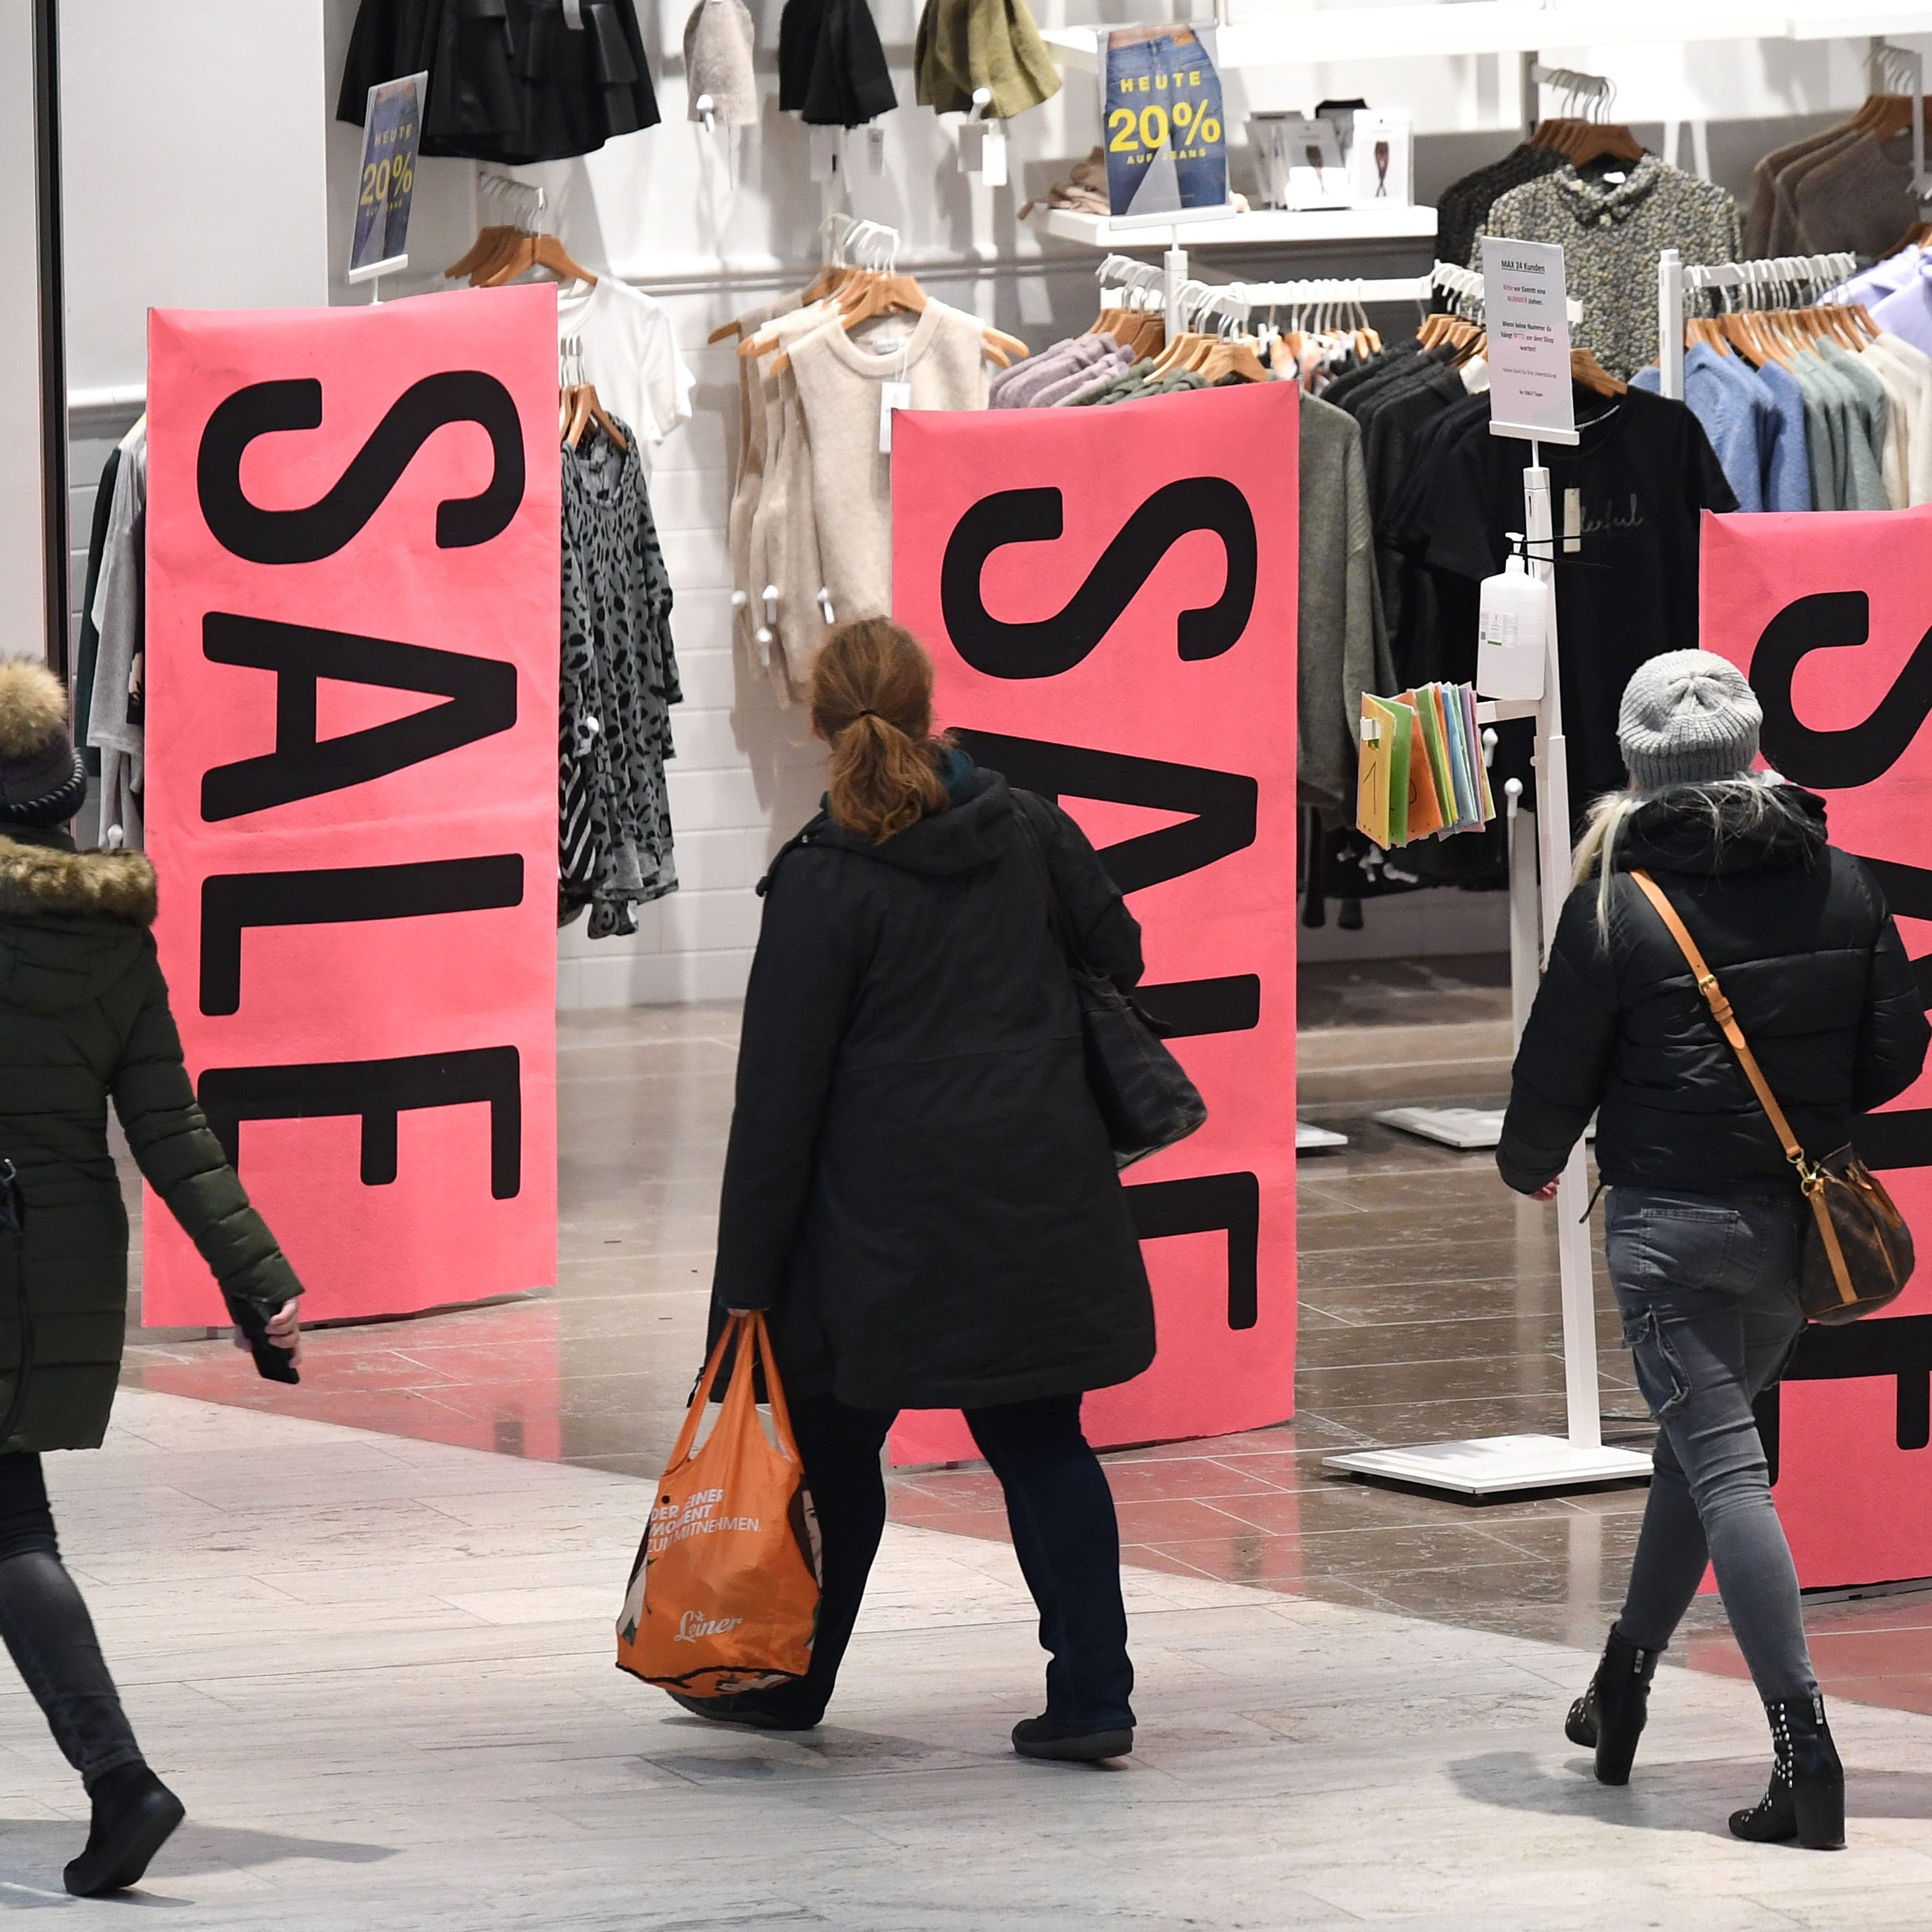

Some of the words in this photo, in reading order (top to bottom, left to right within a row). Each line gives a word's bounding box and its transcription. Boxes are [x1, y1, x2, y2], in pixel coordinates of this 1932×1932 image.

[1120, 71, 1201, 93] HEUTE
[374, 123, 413, 147] HEUTE
[1108, 99, 1221, 153] 20%
[1127, 154, 1153, 165] AUF
[360, 151, 413, 205] 20%
[1501, 259, 1515, 268] MAX
[1516, 261, 1523, 270] 24
[1524, 264, 1545, 272] Kunden
[198, 372, 524, 1199] SALE
[651, 1505, 679, 1521] DER
[674, 1610, 743, 1643] Leiner
